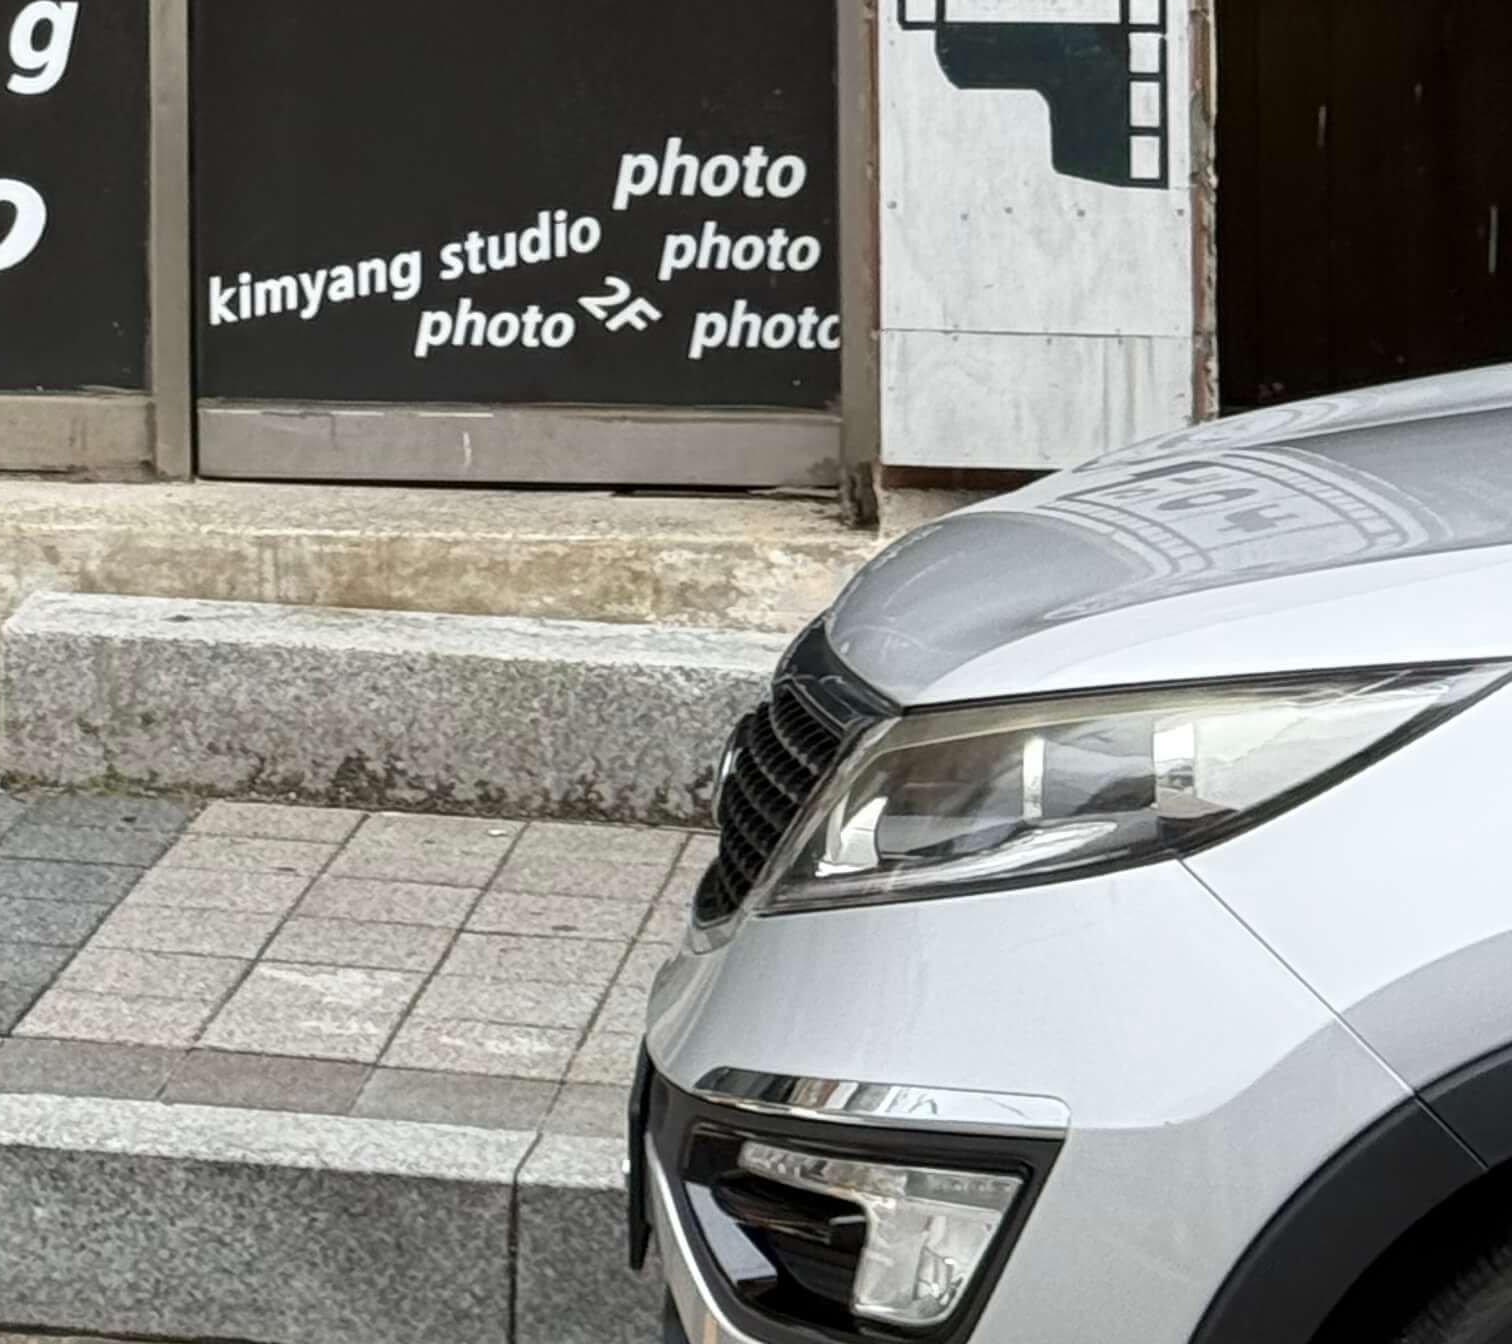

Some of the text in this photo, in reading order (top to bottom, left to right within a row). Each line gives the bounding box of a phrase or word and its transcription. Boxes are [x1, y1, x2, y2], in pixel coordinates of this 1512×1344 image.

[612, 136, 807, 210] photo
[207, 209, 602, 326] kimyang studio
[657, 220, 821, 280] photo
[414, 297, 575, 357] photo
[578, 275, 663, 334] 2F
